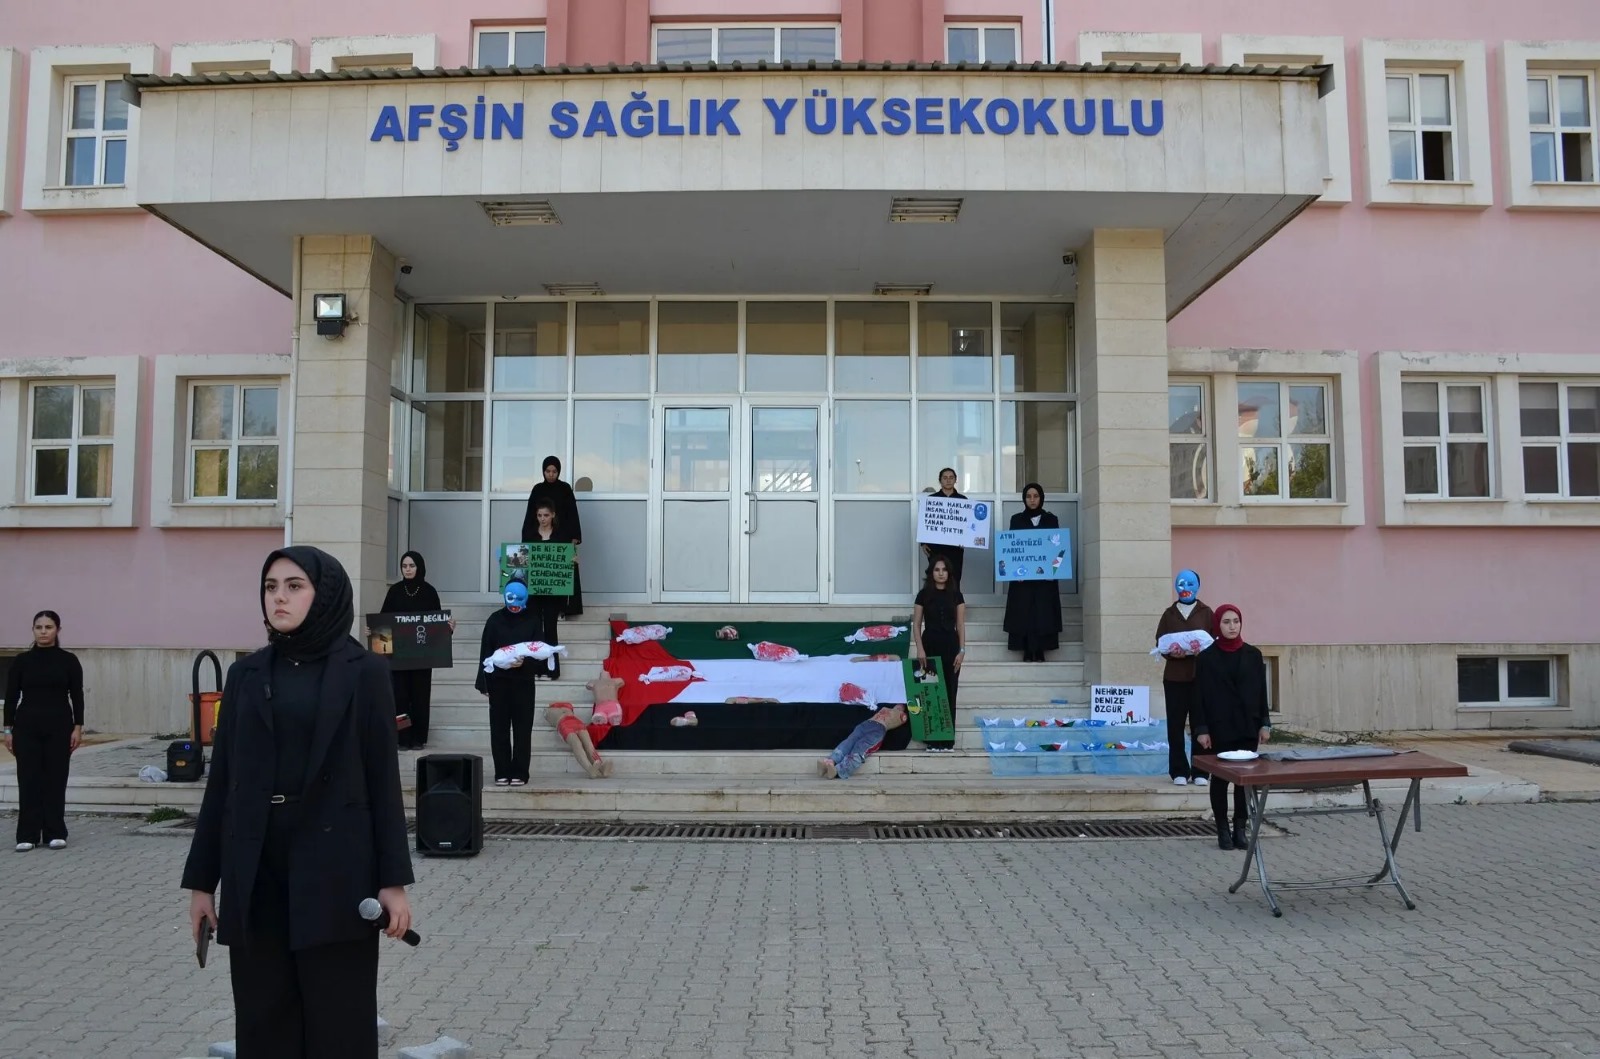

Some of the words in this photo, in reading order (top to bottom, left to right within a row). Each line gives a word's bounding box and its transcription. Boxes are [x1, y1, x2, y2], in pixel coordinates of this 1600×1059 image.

[370, 95, 524, 152] AFŞİN
[549, 91, 741, 139] SAĞLIK
[763, 89, 1164, 137] YÜKSEKOKULU
[395, 615, 421, 623] TARAF
[1094, 705, 1122, 713] ÖZGÜR
